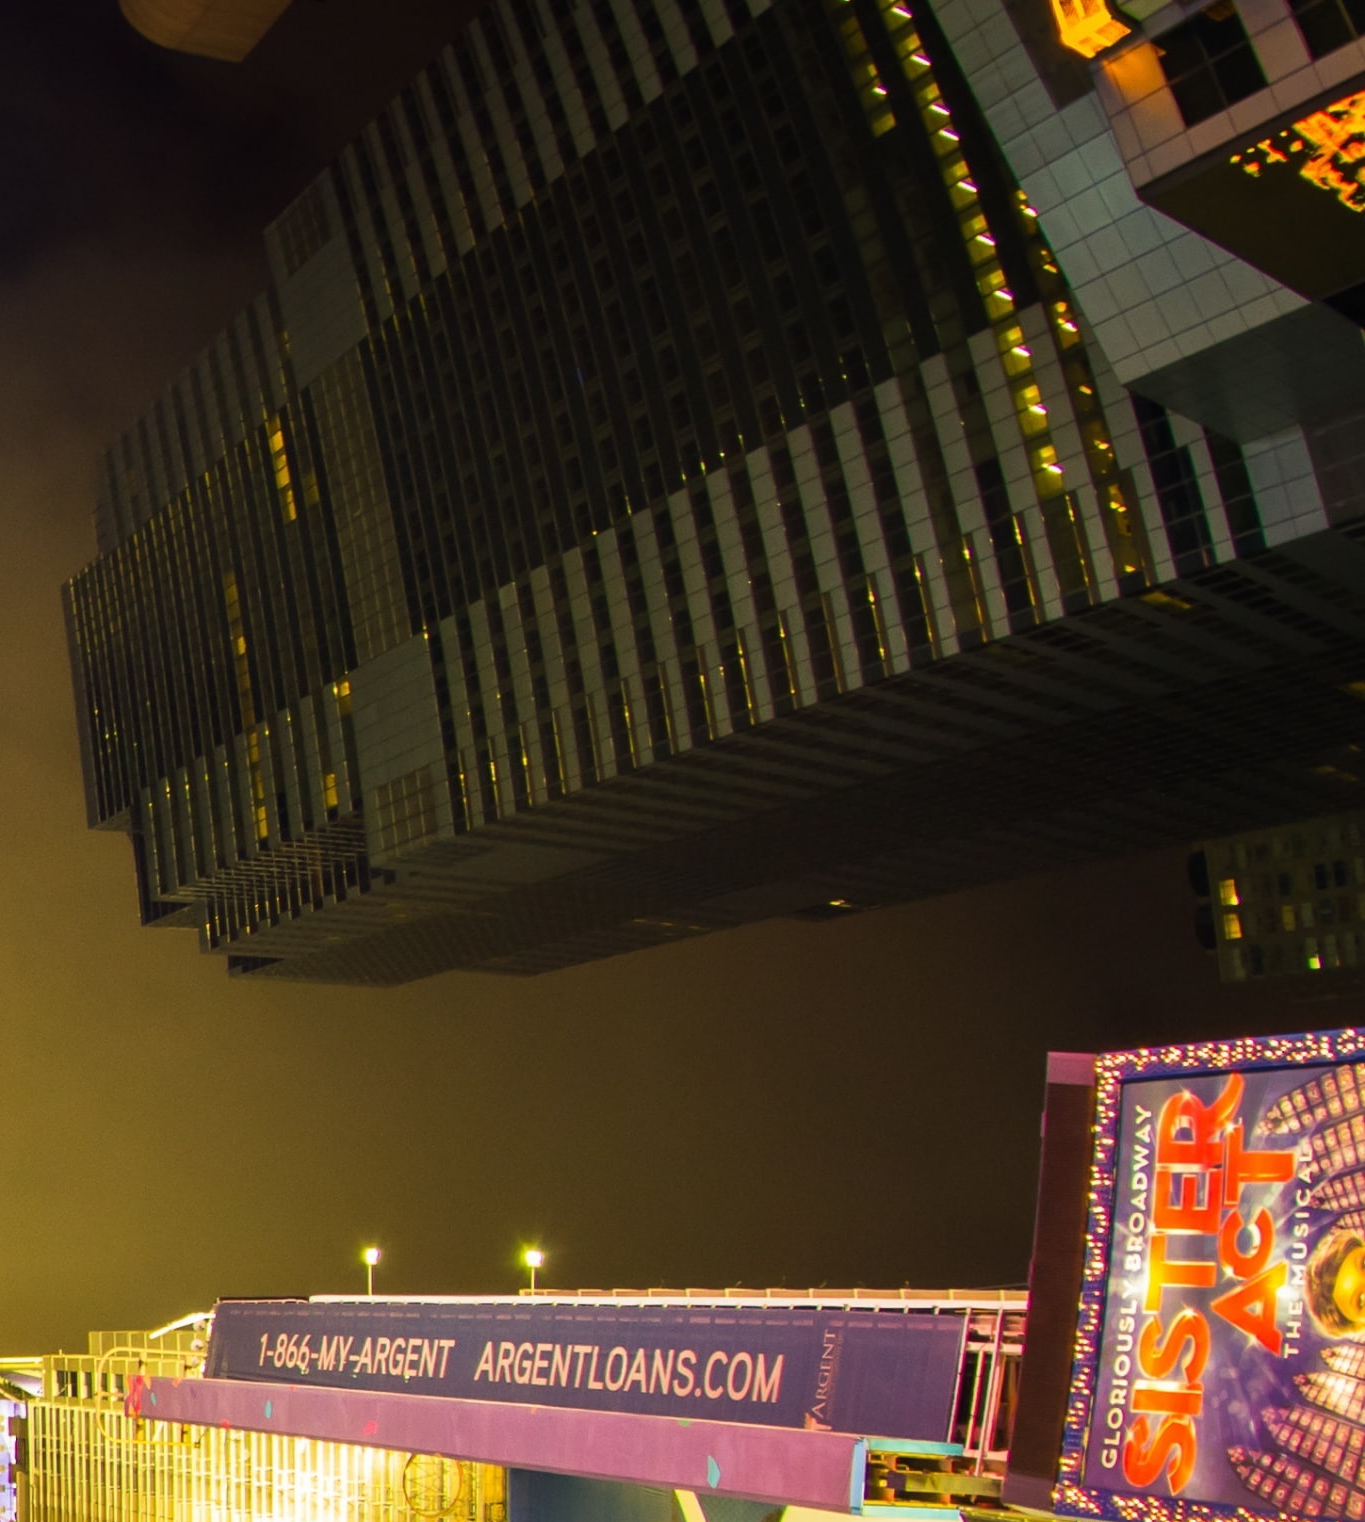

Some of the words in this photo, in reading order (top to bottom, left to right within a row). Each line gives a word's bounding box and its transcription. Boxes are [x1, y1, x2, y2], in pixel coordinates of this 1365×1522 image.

[1101, 1279, 1138, 1468] GLORIOUSLY
[1124, 1104, 1152, 1272] BROADWAY
[1123, 1073, 1246, 1495] SISTER
[1211, 1127, 1298, 1358] ACT
[1289, 1143, 1313, 1286] MUSICAL
[258, 1330, 454, 1381] 1-866-MY-ARGENT
[474, 1341, 785, 1405] ARGENTLOANS.COM
[1282, 1297, 1304, 1359] THE
